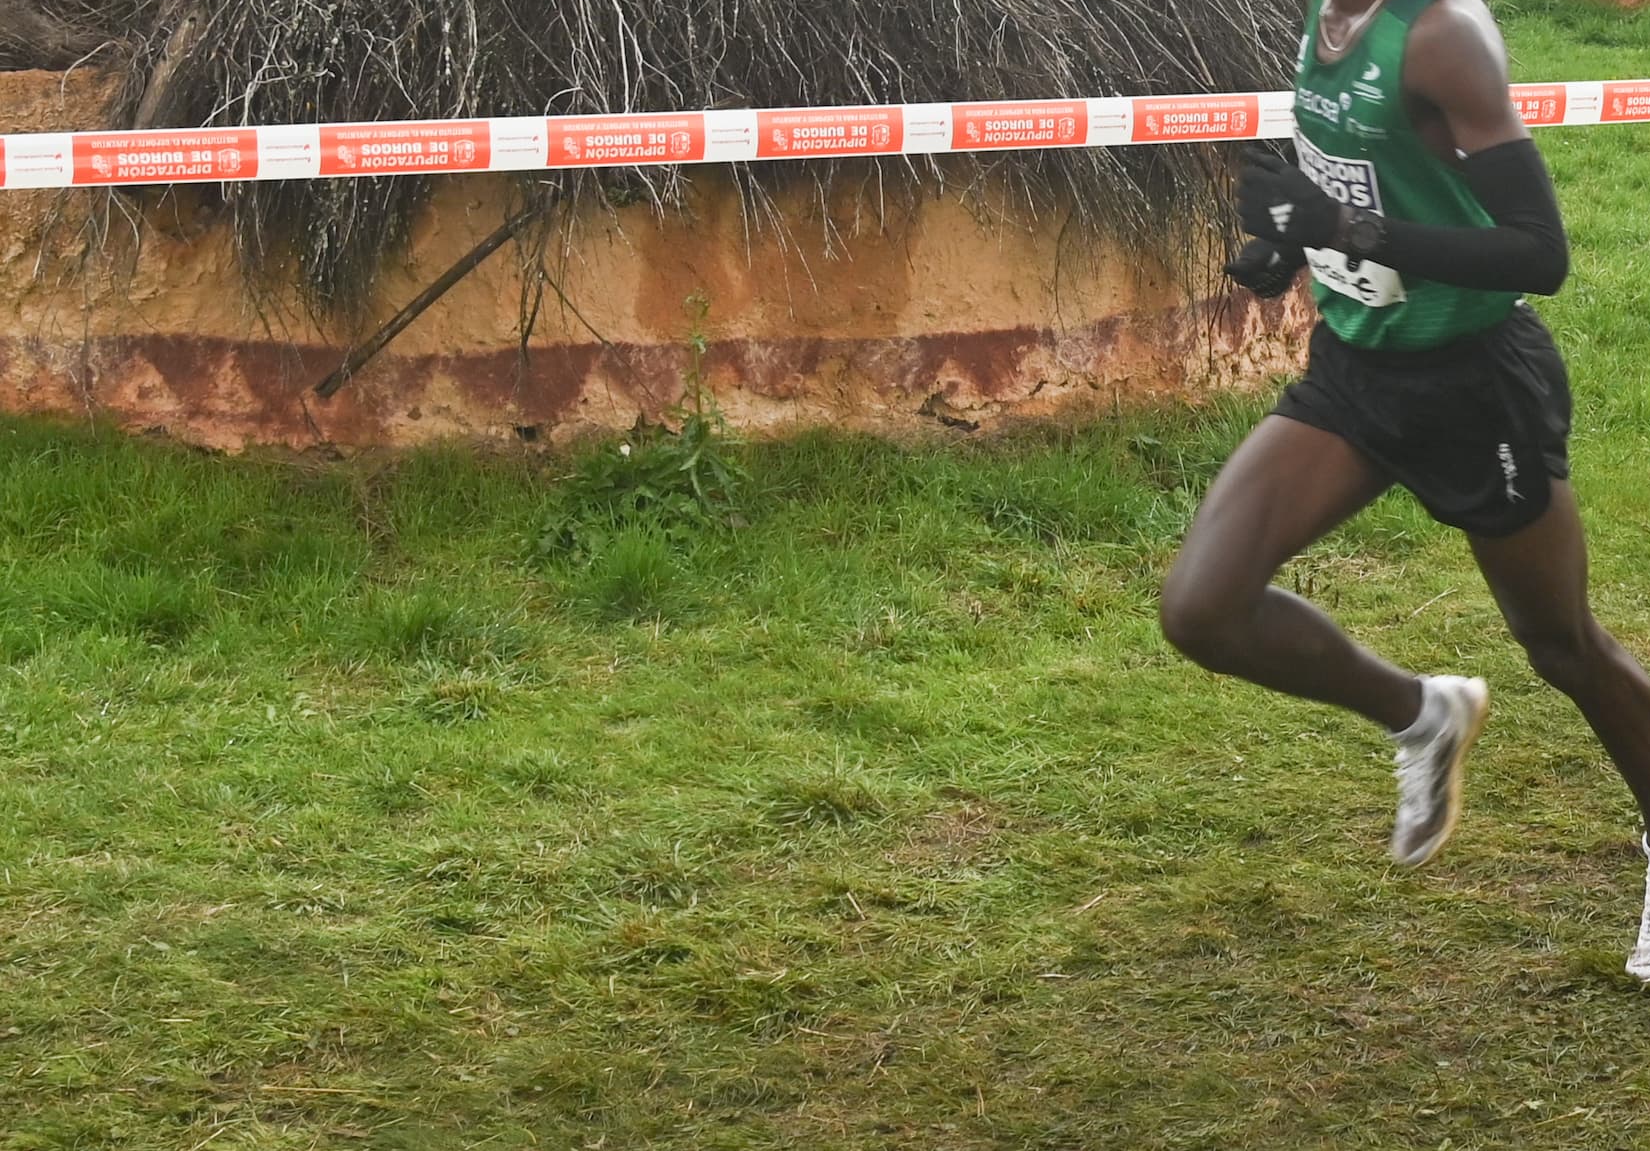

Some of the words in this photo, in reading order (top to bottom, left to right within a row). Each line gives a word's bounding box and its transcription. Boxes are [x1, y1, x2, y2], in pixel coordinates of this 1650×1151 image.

[1527, 101, 1539, 110] DE
[1164, 114, 1208, 123] BURGOS
[1213, 112, 1227, 121] DE
[986, 120, 1033, 130] BURGOS
[1039, 119, 1054, 128] DE
[1163, 123, 1226, 135] DIPUTACIÓN
[793, 126, 844, 138] BURGOS
[851, 126, 867, 136] DE
[984, 130, 1054, 142] DIPUTACIÓN
[586, 134, 642, 146] BURGOS
[648, 134, 666, 144] DE
[792, 138, 867, 151] DIPUTACIÓN
[361, 143, 422, 156] BURGOS
[429, 142, 448, 152] DE
[586, 146, 666, 159] DIPUTACIÓN
[118, 152, 184, 166] BURGOS
[191, 150, 212, 162] DE
[361, 154, 448, 168] DIPUTACIÓN
[118, 162, 212, 178] DIPUTACIÓN
